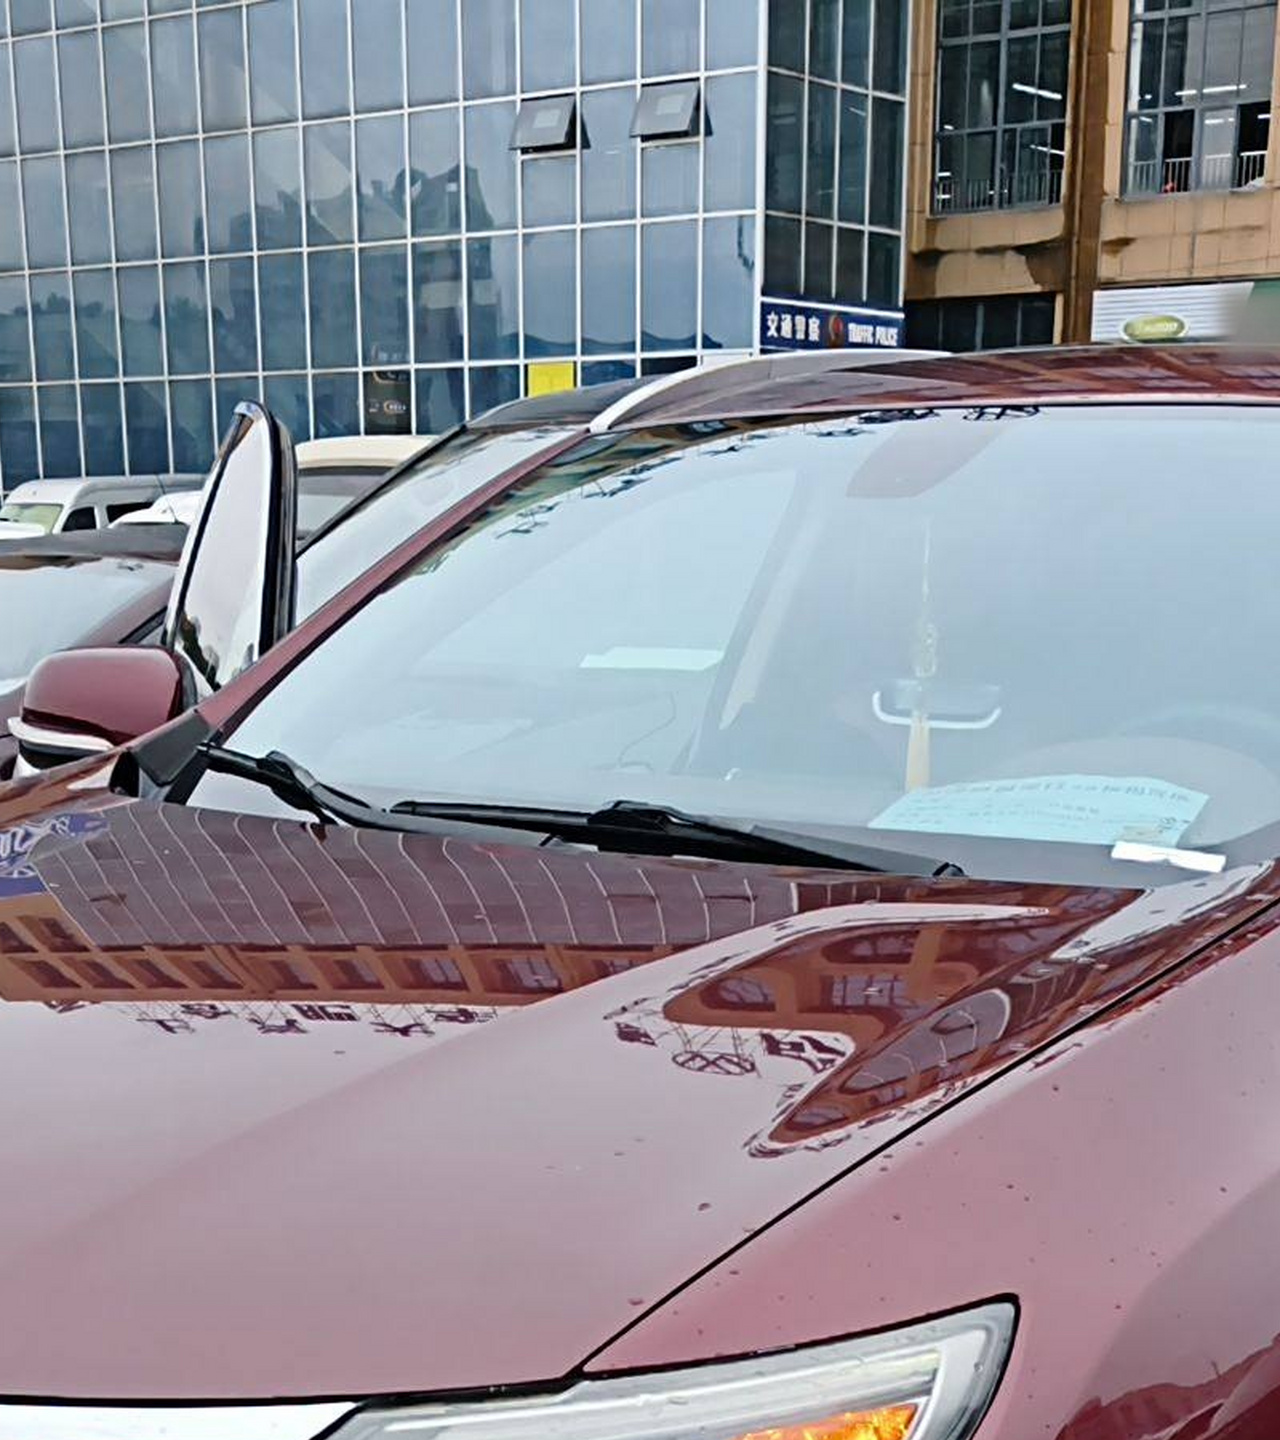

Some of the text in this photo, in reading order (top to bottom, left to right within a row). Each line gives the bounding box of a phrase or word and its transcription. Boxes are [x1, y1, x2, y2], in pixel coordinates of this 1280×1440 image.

[767, 311, 820, 342] 交通警察
[847, 322, 898, 346] TRAFFIC POLICE
